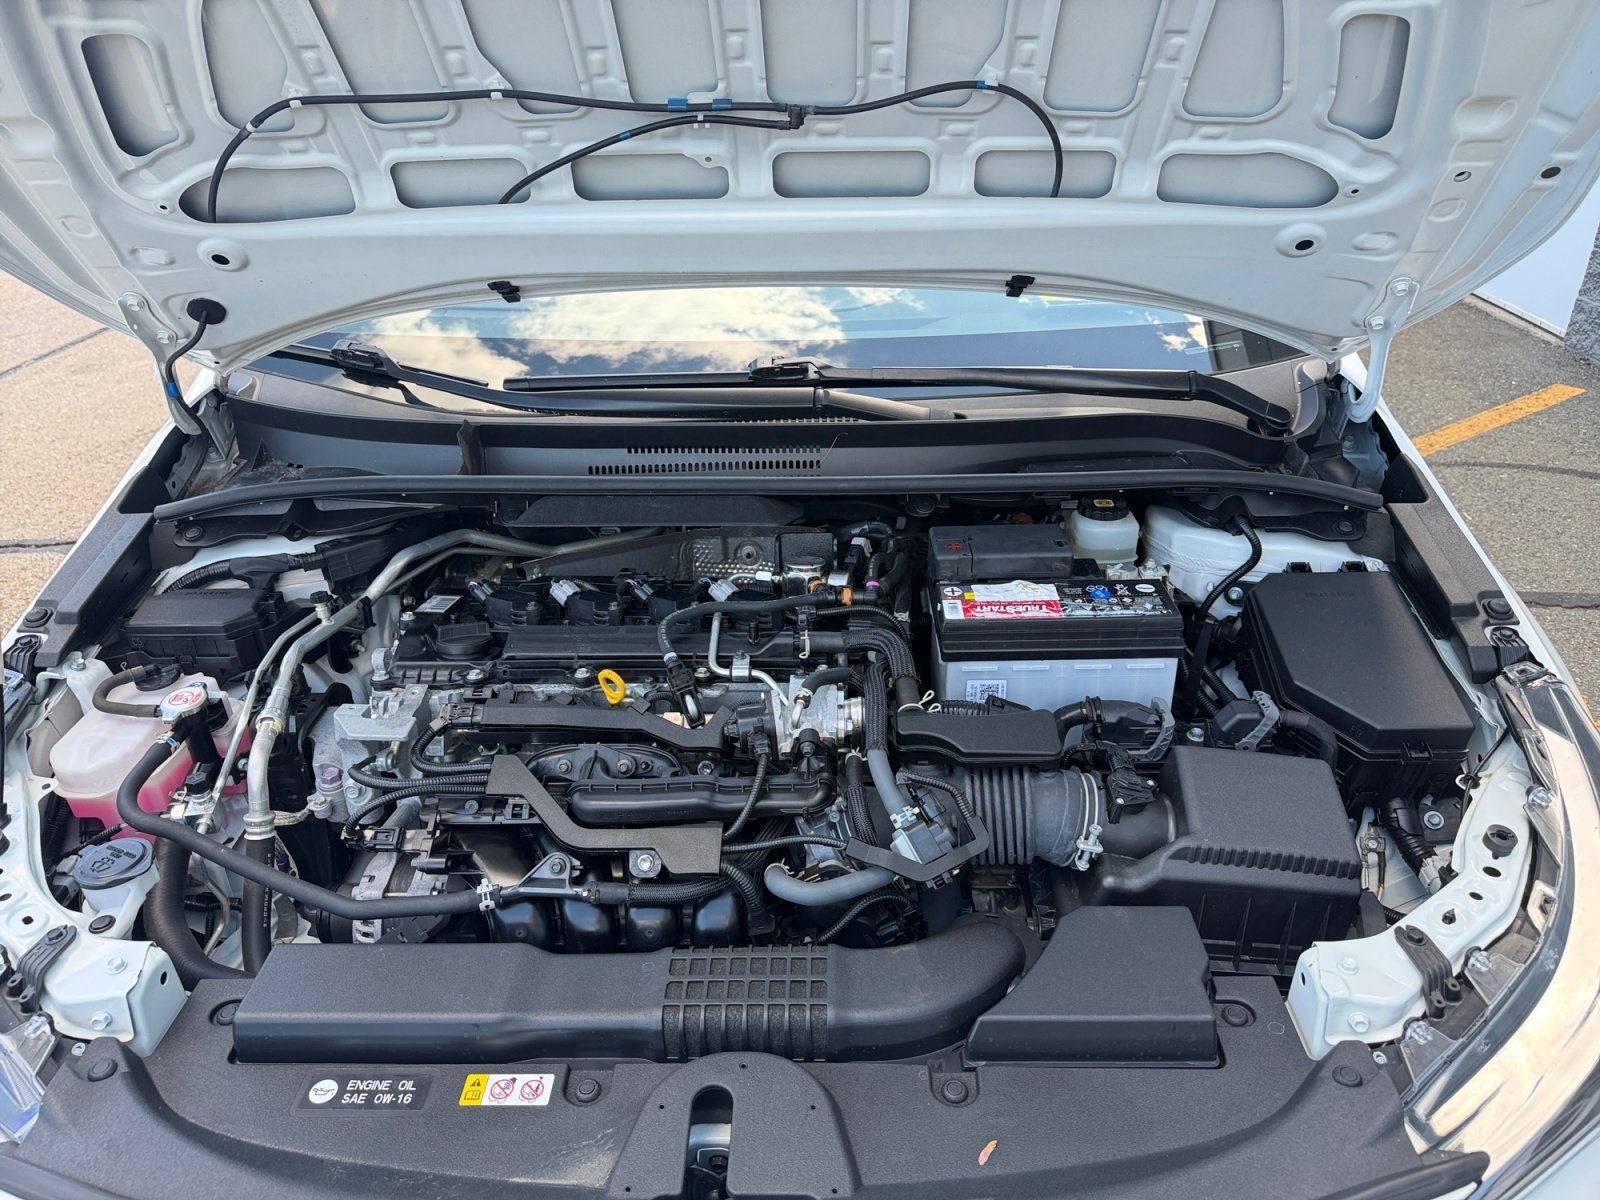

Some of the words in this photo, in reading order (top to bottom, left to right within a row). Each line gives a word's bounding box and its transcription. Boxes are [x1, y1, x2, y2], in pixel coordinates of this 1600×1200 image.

[346, 1079, 392, 1091] ENGINE
[398, 1079, 417, 1091] OIL
[341, 1093, 368, 1104] SAE
[373, 1093, 413, 1104] 0W-16
